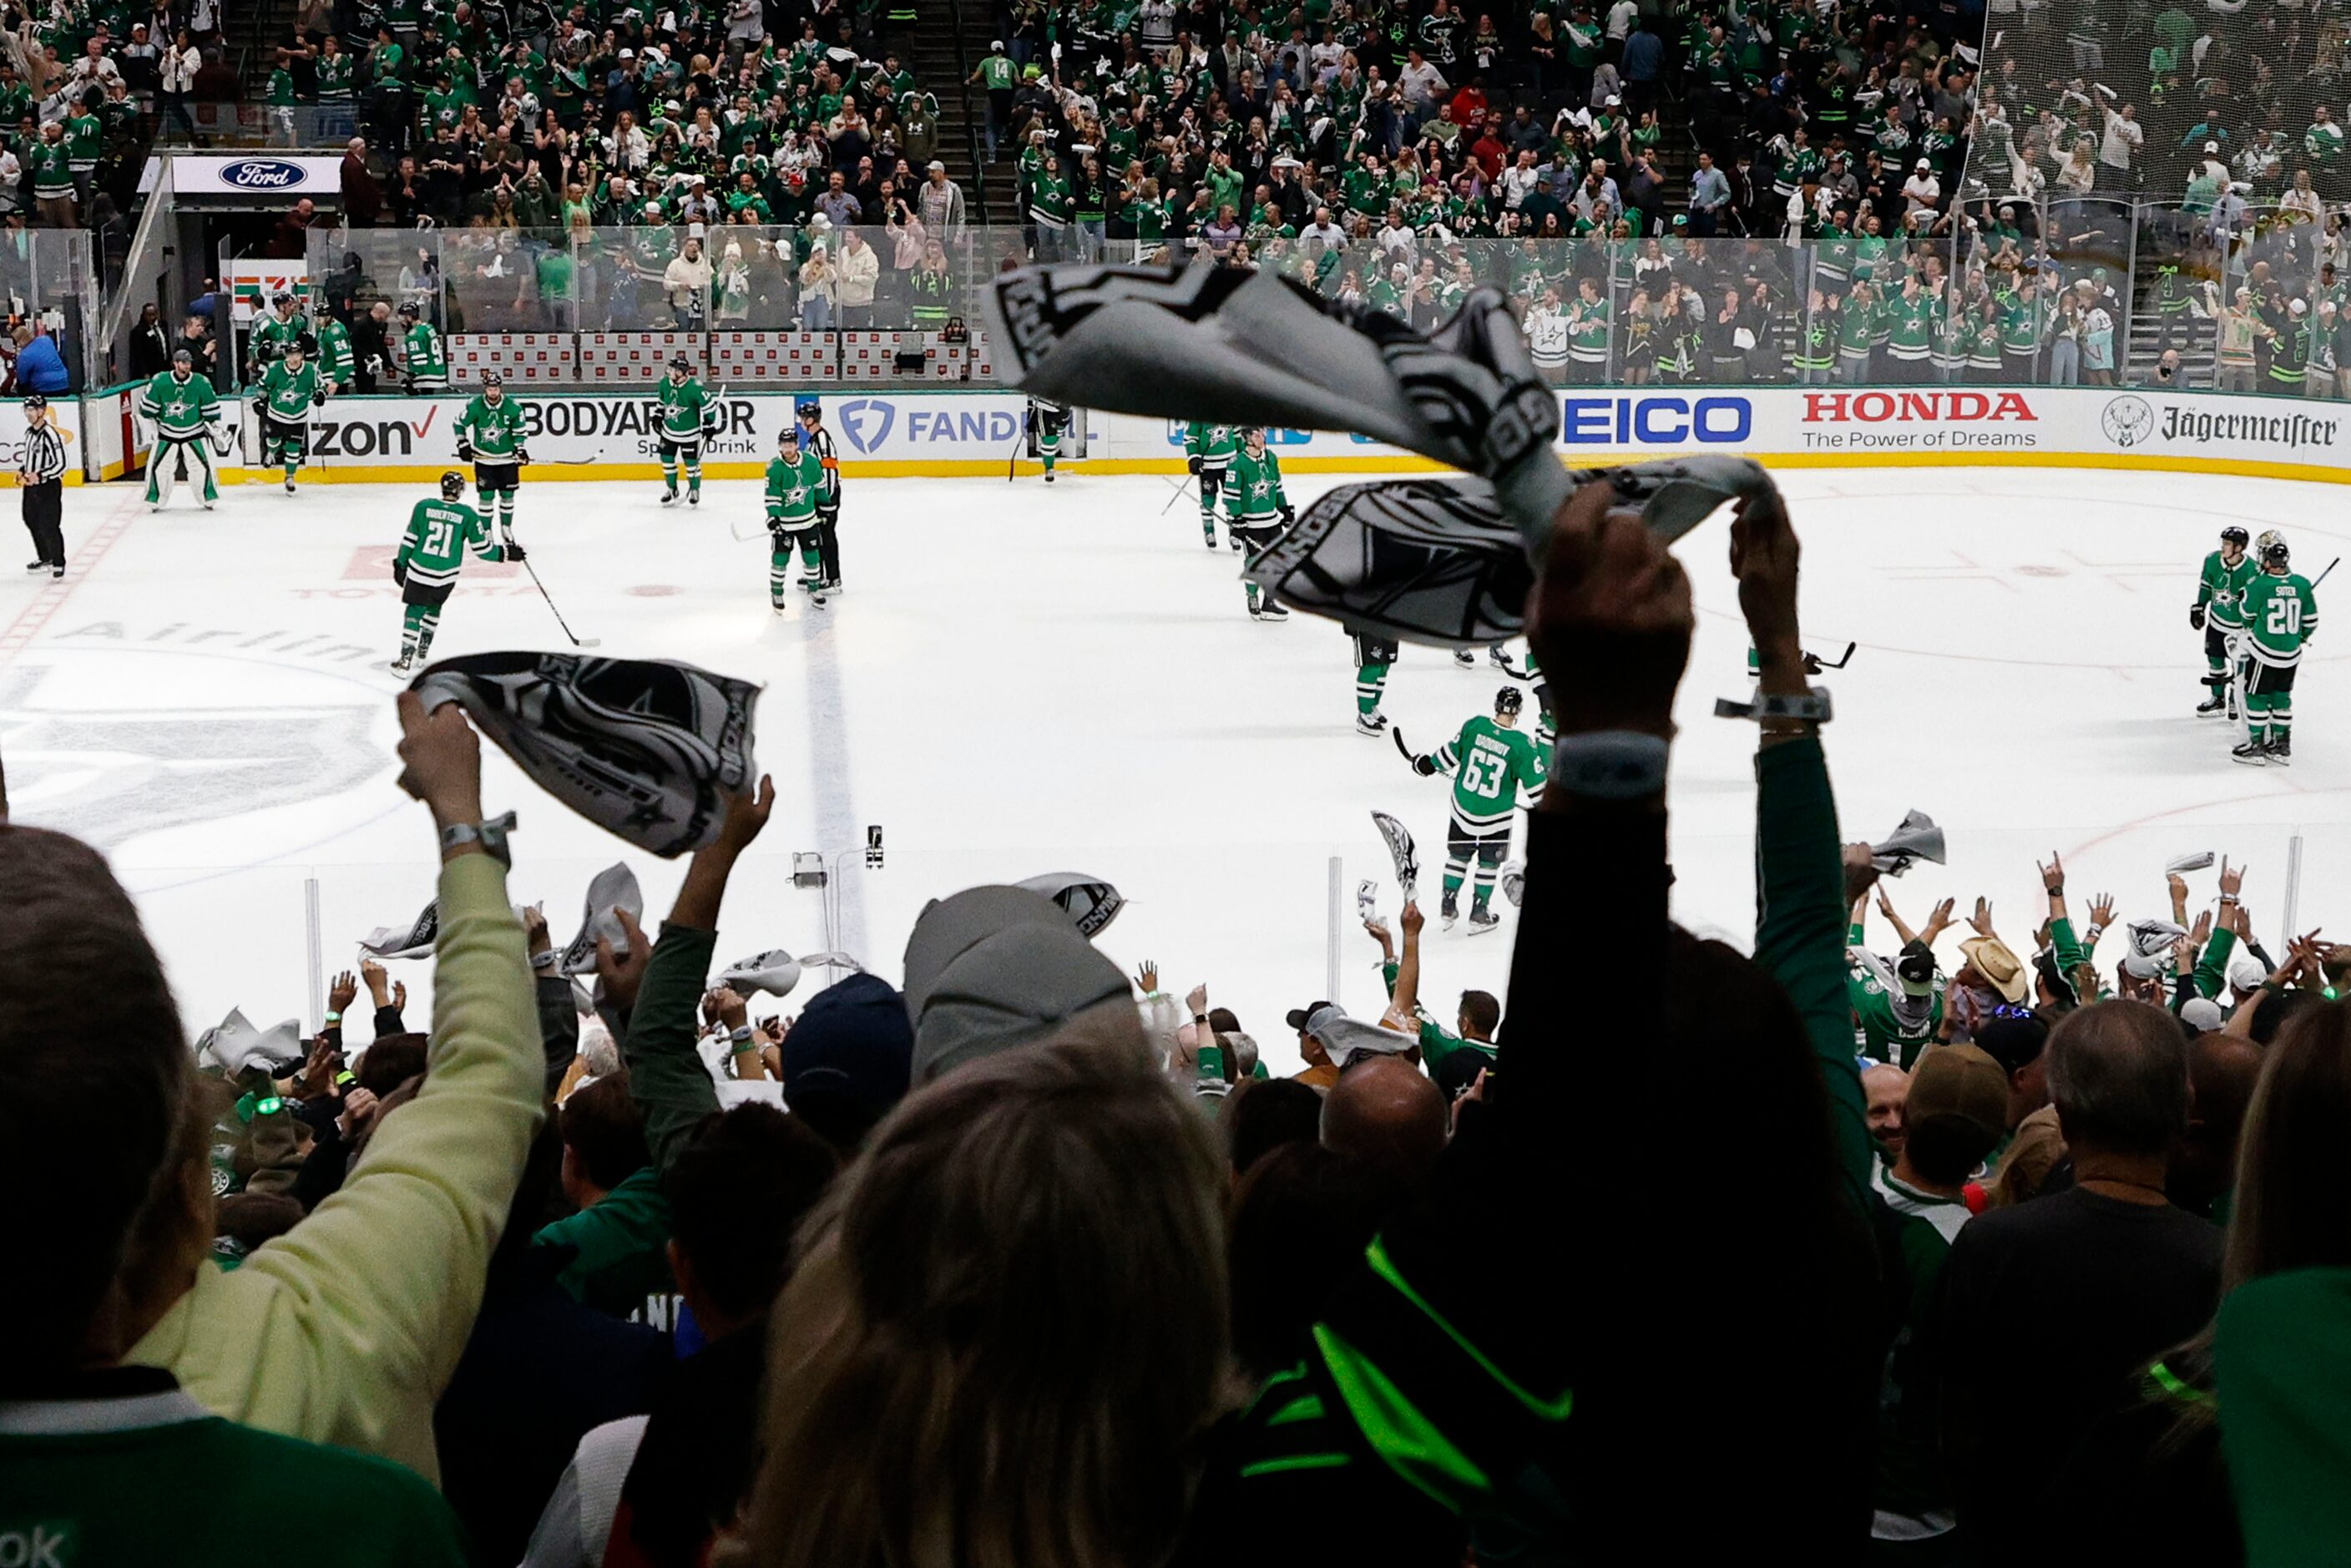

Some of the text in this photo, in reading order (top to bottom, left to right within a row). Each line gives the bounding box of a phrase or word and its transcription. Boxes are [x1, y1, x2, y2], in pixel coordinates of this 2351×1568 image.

[994, 62, 1009, 78] 14
[236, 163, 290, 185] Ford
[519, 401, 756, 437] BODYAROR
[1564, 397, 1752, 444] EICO
[1802, 392, 2039, 422] HONDA
[706, 440, 756, 453] Drink
[1802, 431, 2037, 447] The Power of Dreams
[422, 520, 454, 559] 21
[2267, 598, 2302, 635] 20
[1462, 747, 1507, 799] 63
